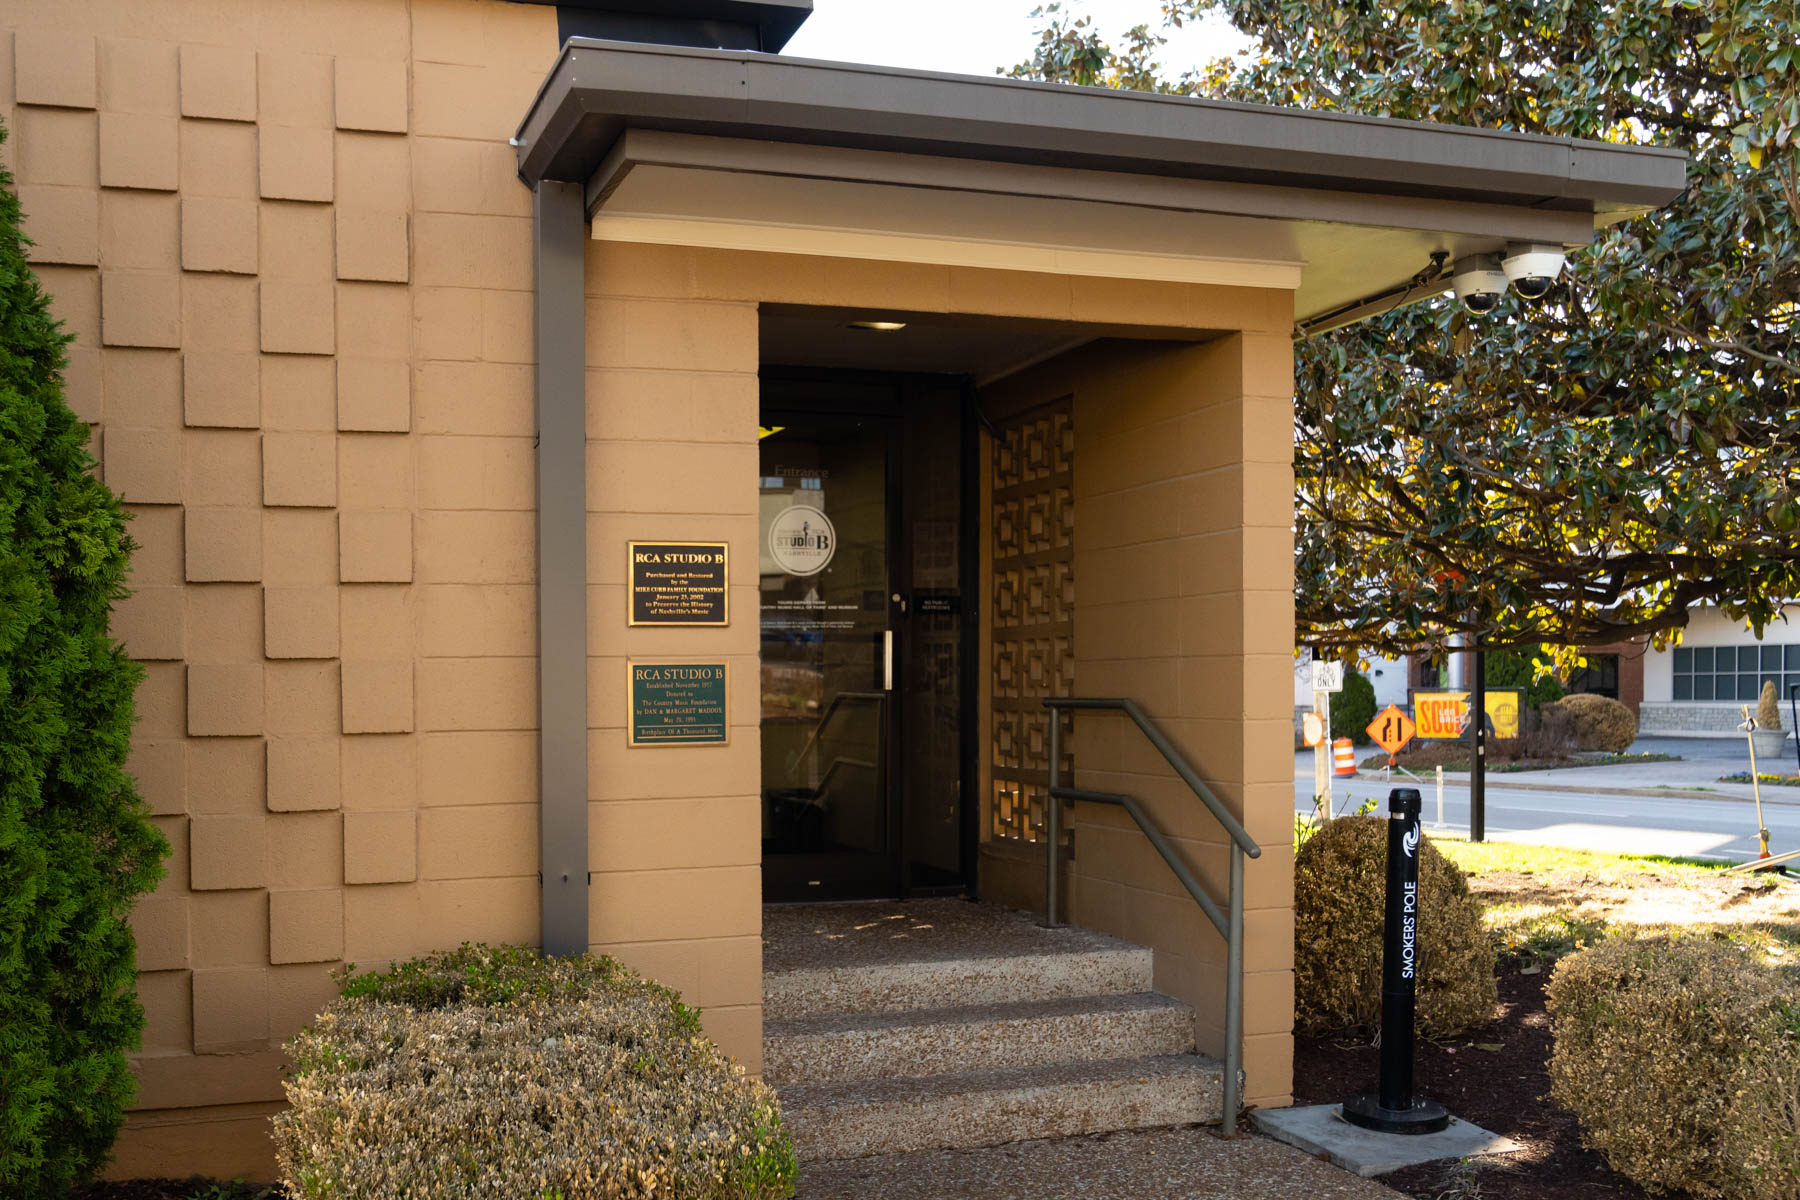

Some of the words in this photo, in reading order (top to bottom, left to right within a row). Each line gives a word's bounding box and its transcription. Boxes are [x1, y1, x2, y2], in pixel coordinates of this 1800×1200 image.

[775, 464, 829, 478] Entrance
[776, 536, 815, 548] STUDIO
[816, 535, 829, 550] B
[635, 553, 661, 563] RCA
[664, 553, 712, 564] STUDIO
[715, 554, 724, 564] B
[635, 669, 661, 680] RCA
[664, 668, 712, 680] STUDIO
[715, 668, 723, 679] B
[1317, 679, 1336, 688] ONLY
[1420, 700, 1464, 734] SOUL
[1403, 881, 1416, 913] POLE
[1402, 915, 1415, 979] SMOKERS'
